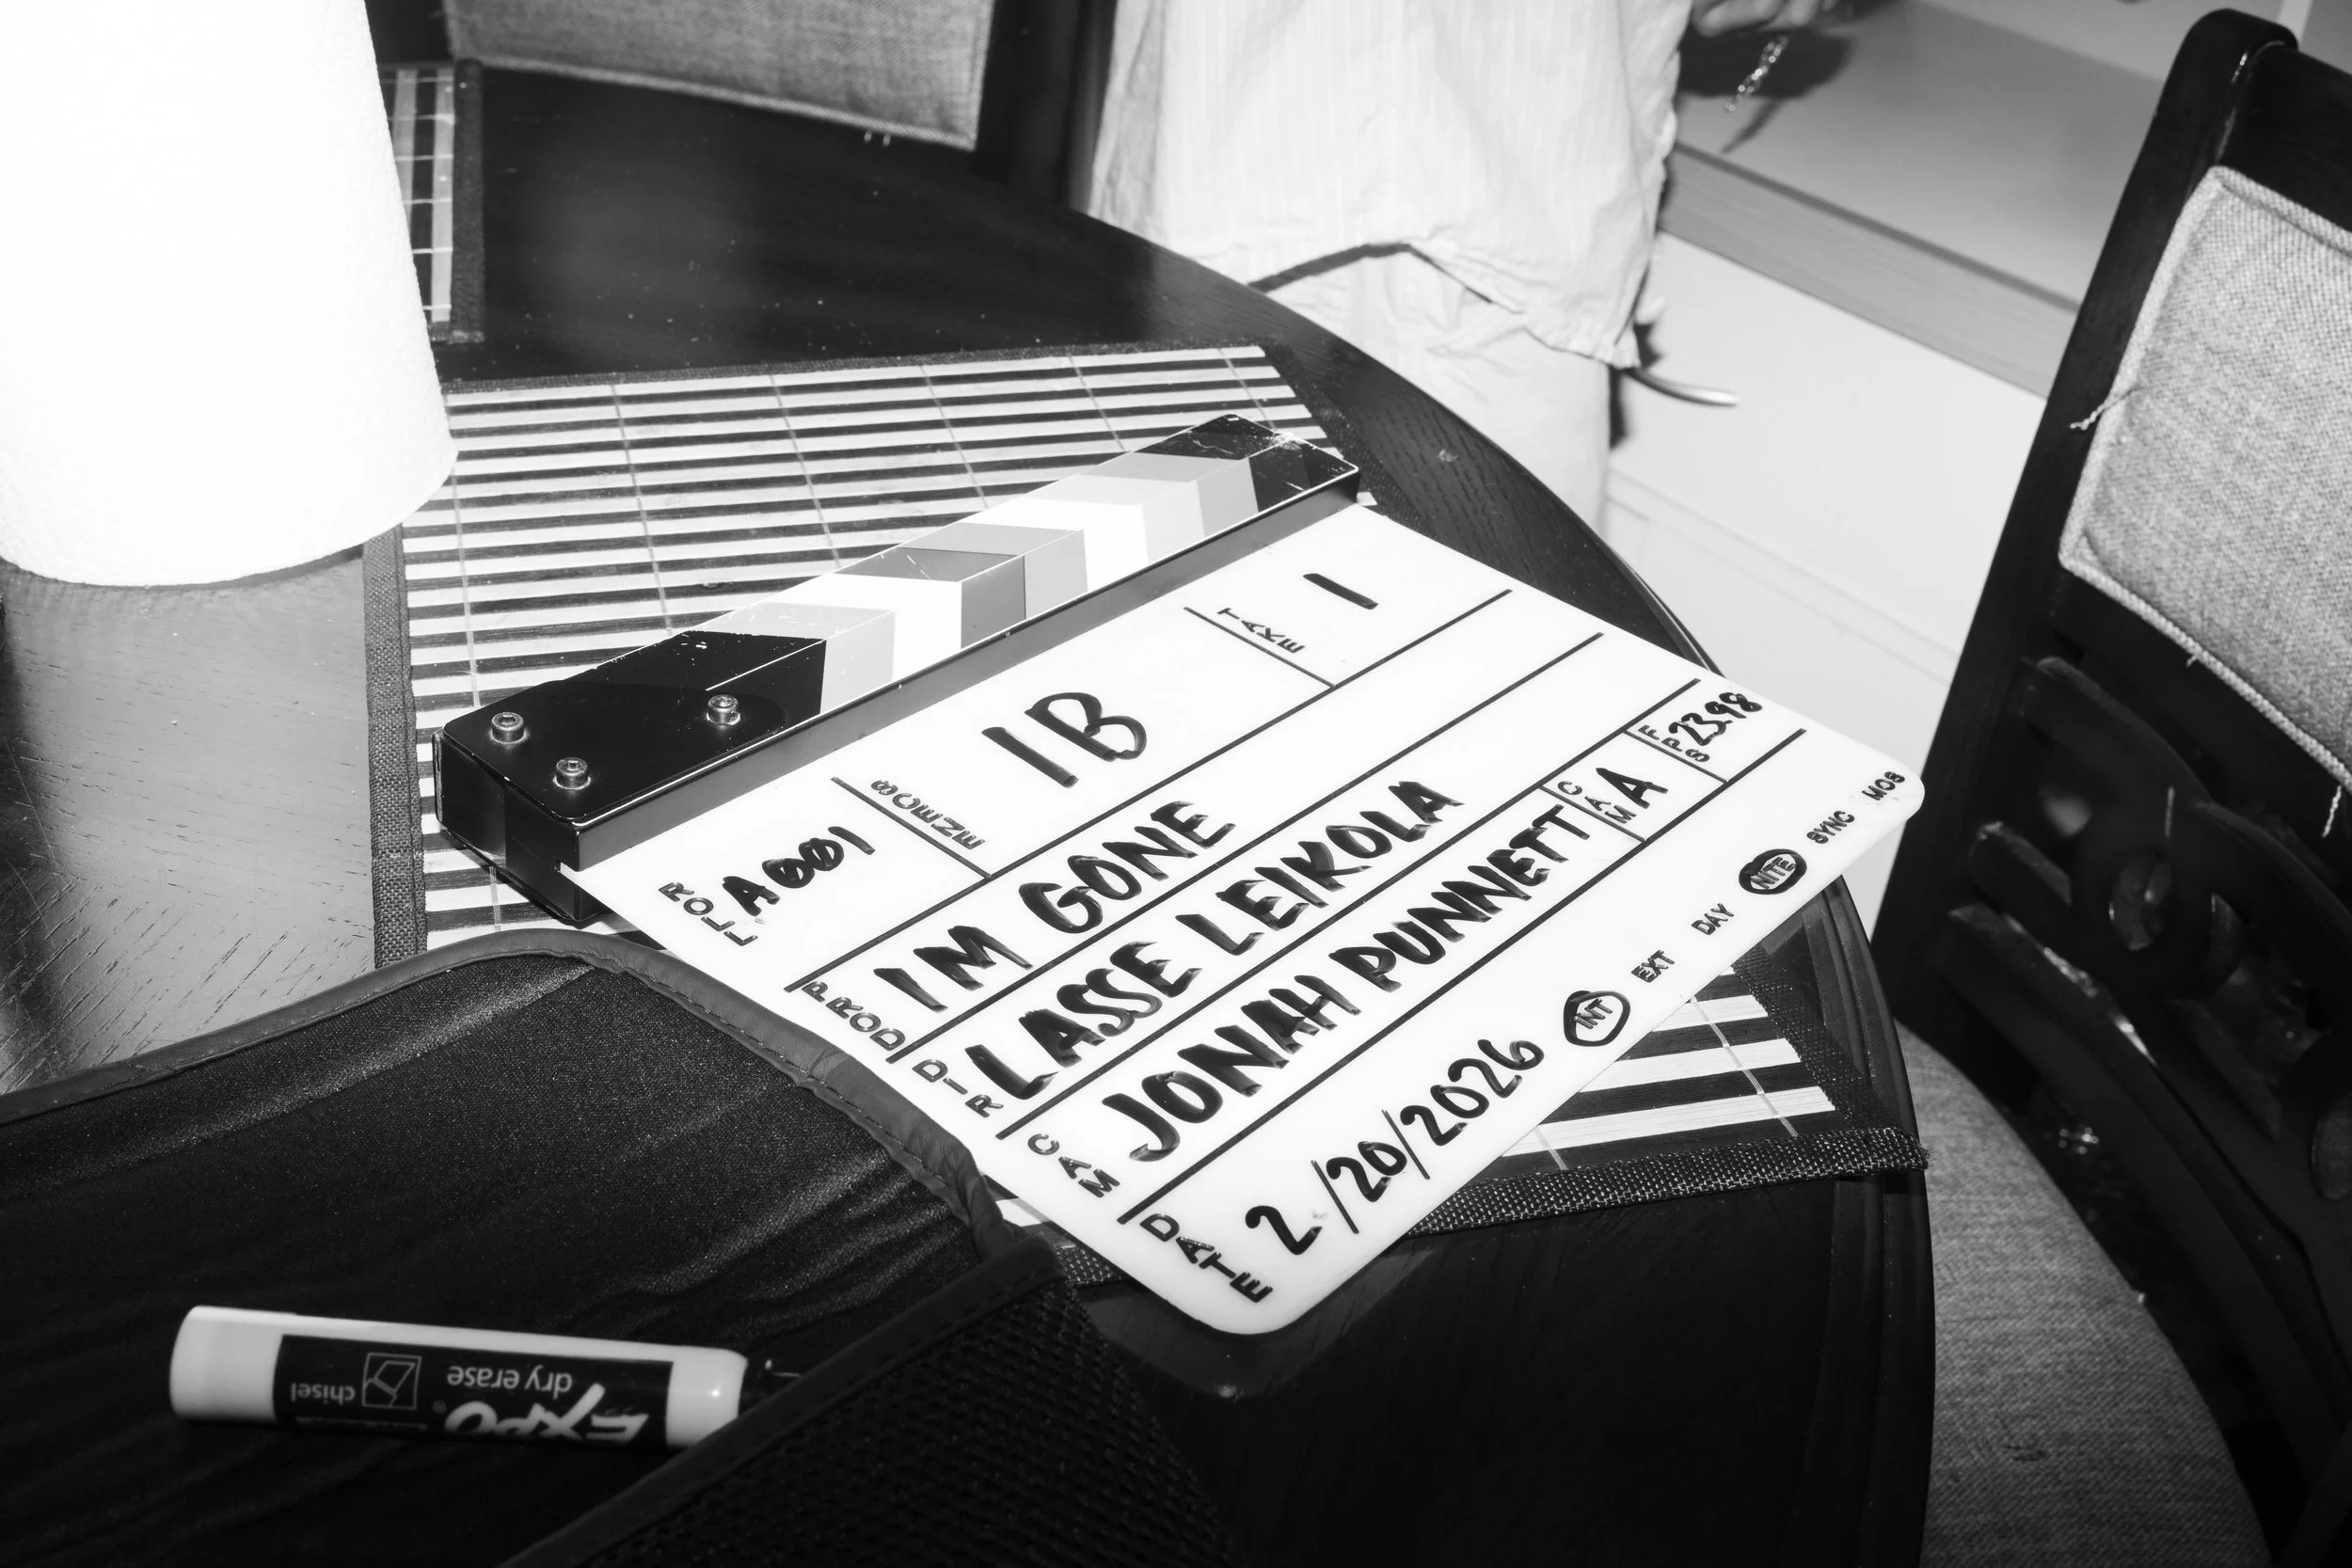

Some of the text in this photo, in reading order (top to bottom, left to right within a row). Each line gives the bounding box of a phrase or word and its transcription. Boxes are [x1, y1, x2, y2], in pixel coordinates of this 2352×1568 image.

[1216, 607, 1306, 654] TAKE
[981, 691, 1147, 788] 1B
[1637, 724, 1710, 763] FPS
[1557, 781, 1637, 824] CAM
[1596, 767, 1669, 809] A
[1861, 771, 1906, 801] MOS
[870, 780, 986, 850] SCENE
[1806, 810, 1855, 845] SYNC
[1749, 856, 1797, 890] NITE
[658, 882, 758, 947] ROLL
[873, 800, 1236, 1013] IM GONE
[1691, 903, 1735, 936] DAY
[965, 781, 1465, 1101] LASSE LEIKOLA
[1102, 803, 1591, 1163] JONAH PUNNETT
[1630, 949, 1676, 983] EXT
[802, 981, 906, 1052] PROD
[1573, 997, 1613, 1030] INT
[912, 1059, 1004, 1118] DIR
[1027, 1133, 1120, 1199] CAM
[1138, 1212, 1274, 1304] DATE
[290, 1382, 356, 1406] chisel
[447, 1364, 574, 1400] dry erase
